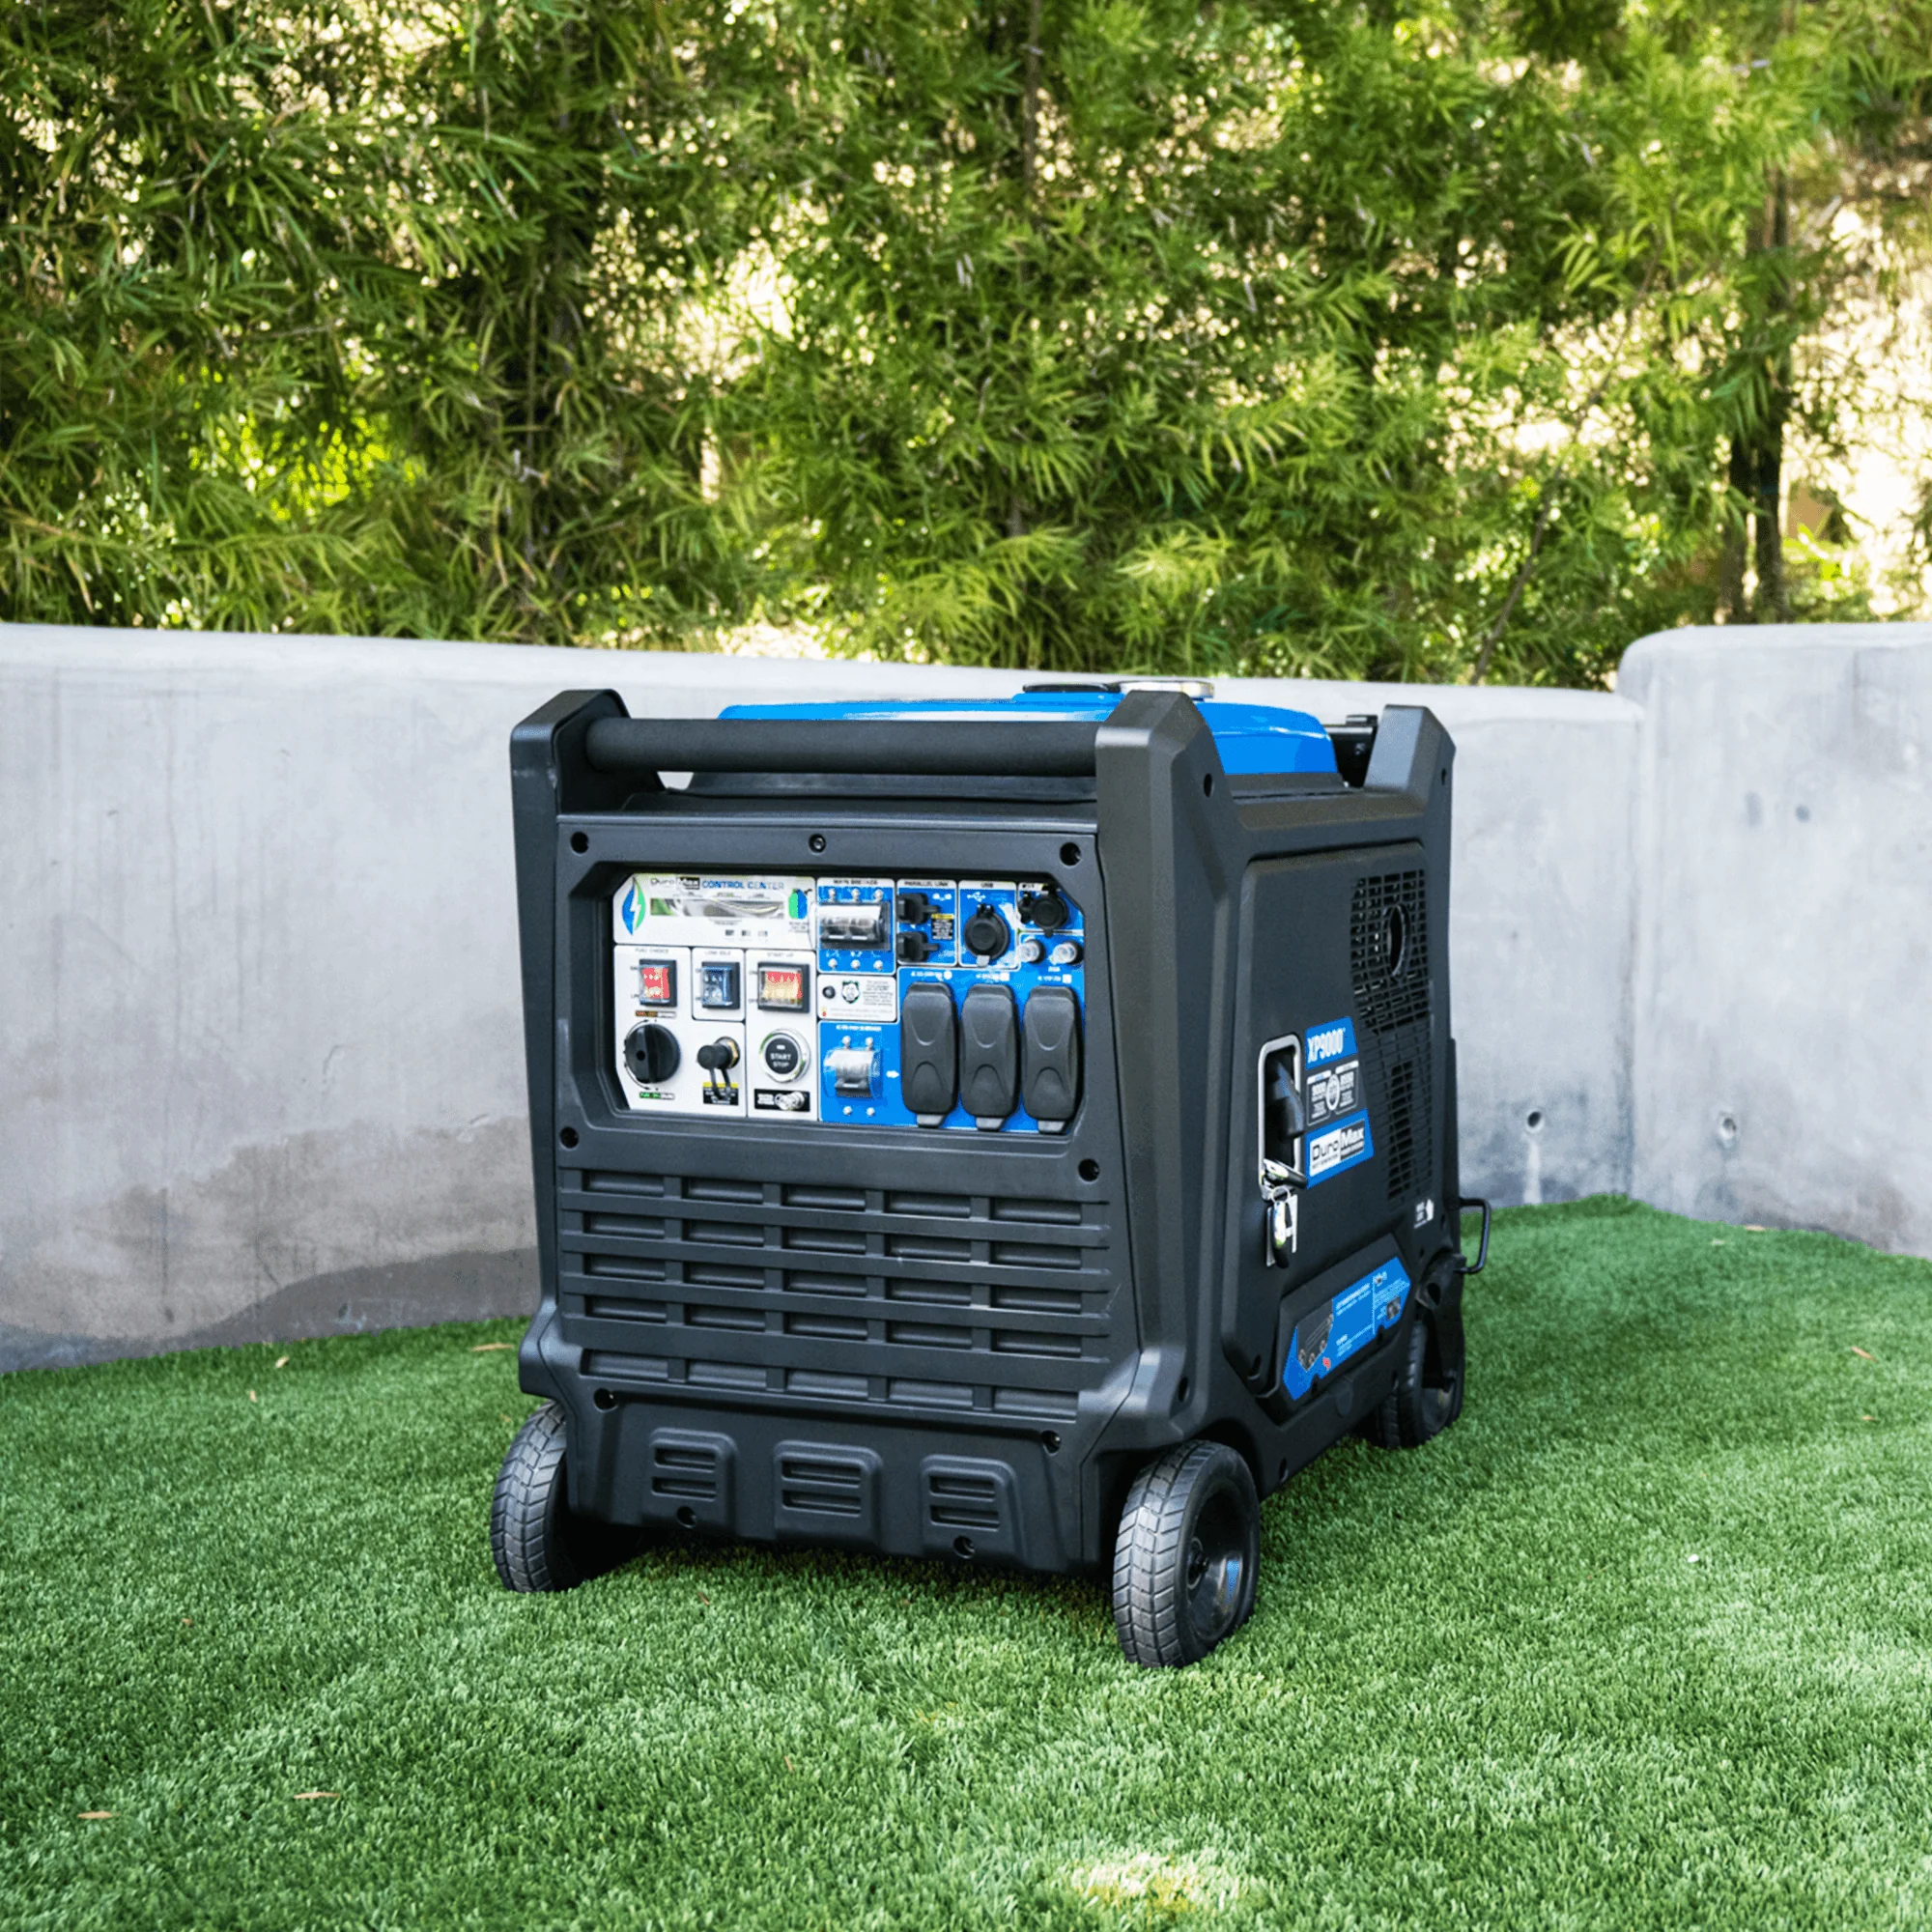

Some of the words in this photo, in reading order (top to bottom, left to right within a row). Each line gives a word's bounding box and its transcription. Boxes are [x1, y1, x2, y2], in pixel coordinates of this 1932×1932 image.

[702, 880, 744, 889] CONTROL
[748, 881, 784, 890] CENTER
[1307, 1028, 1344, 1064] XP9000
